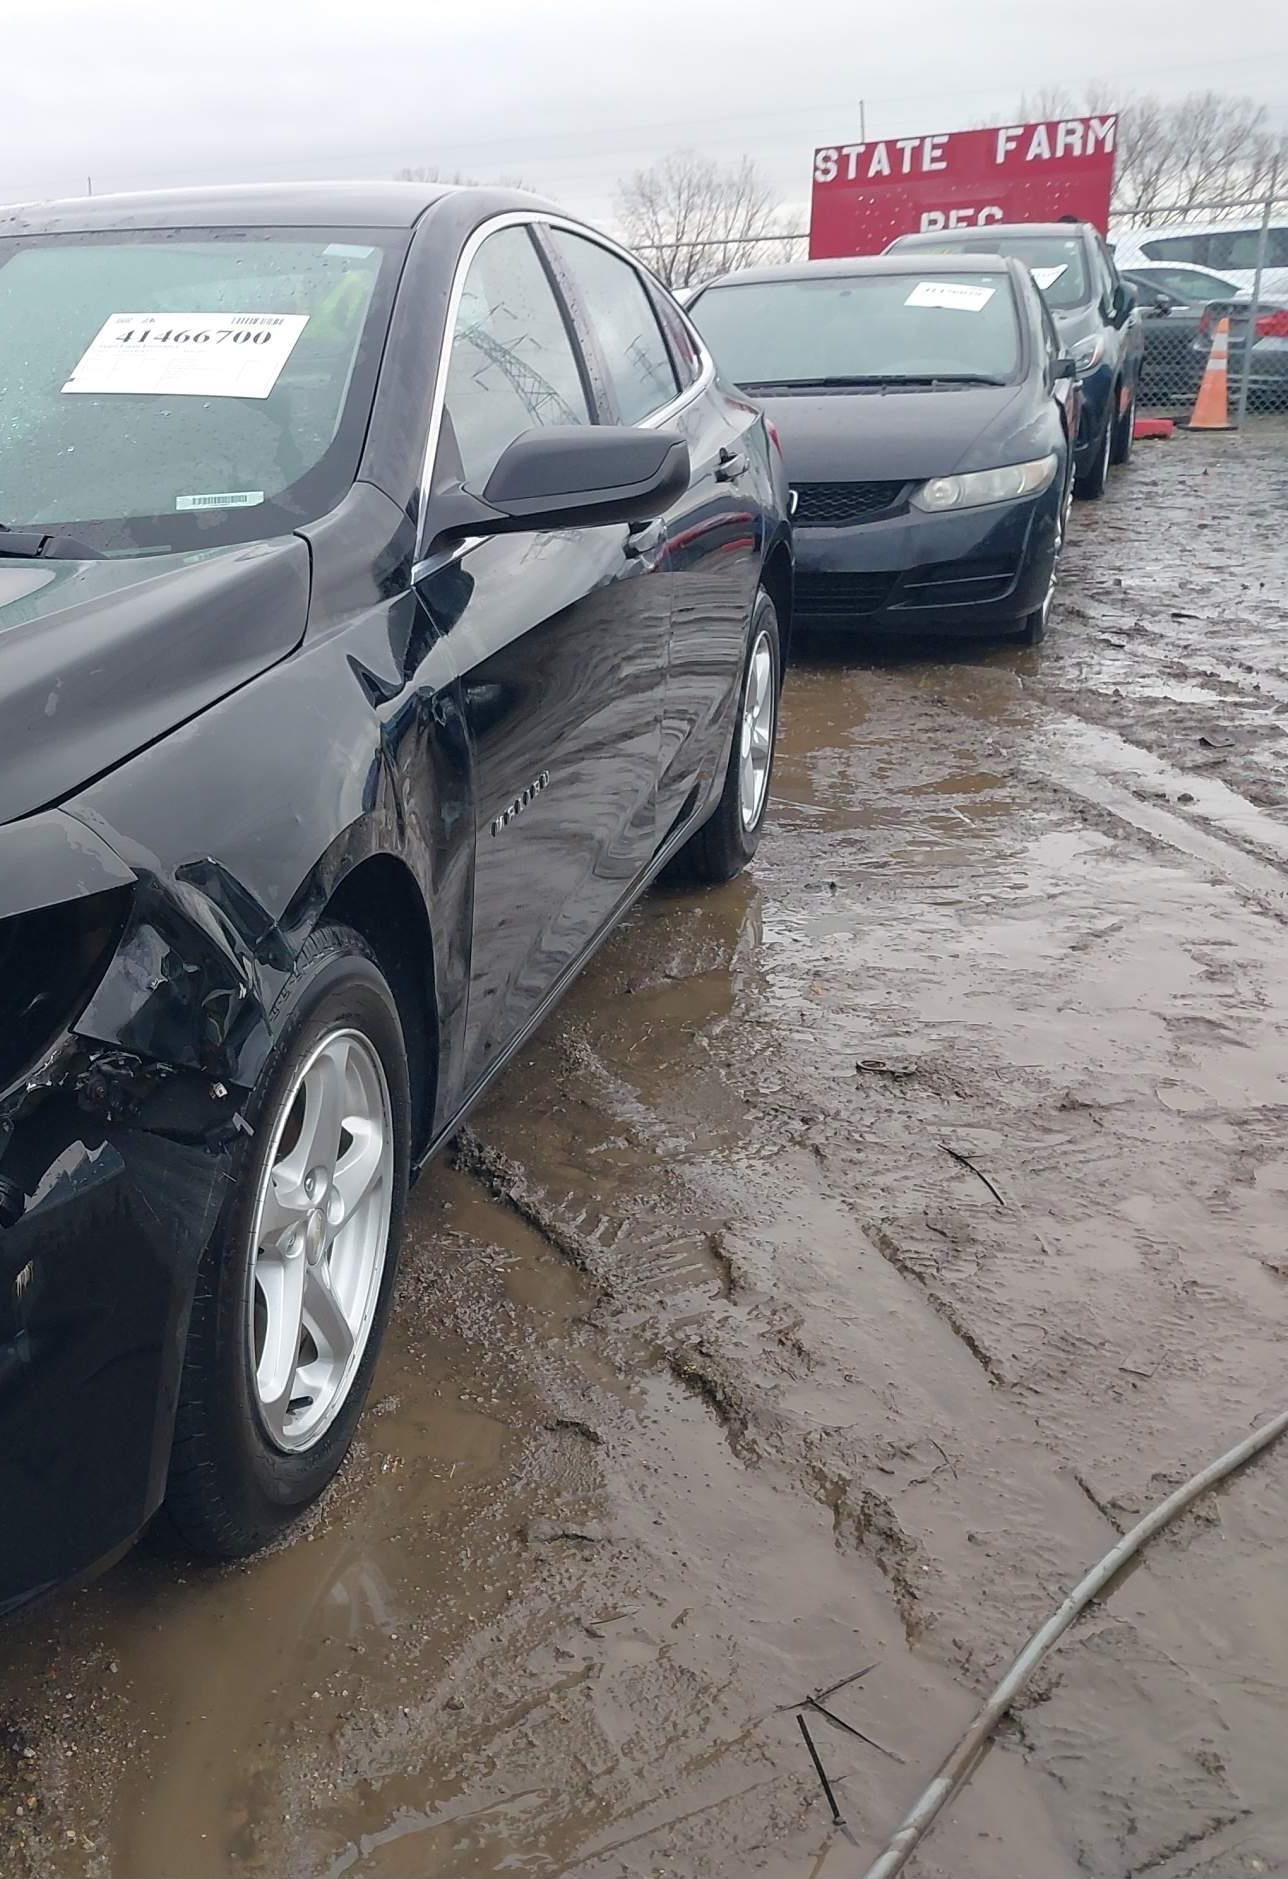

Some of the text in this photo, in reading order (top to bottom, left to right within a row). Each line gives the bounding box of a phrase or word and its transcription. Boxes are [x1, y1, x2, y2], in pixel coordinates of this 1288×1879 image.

[814, 116, 1116, 183] STATE FARM
[115, 329, 272, 345] 41466700
